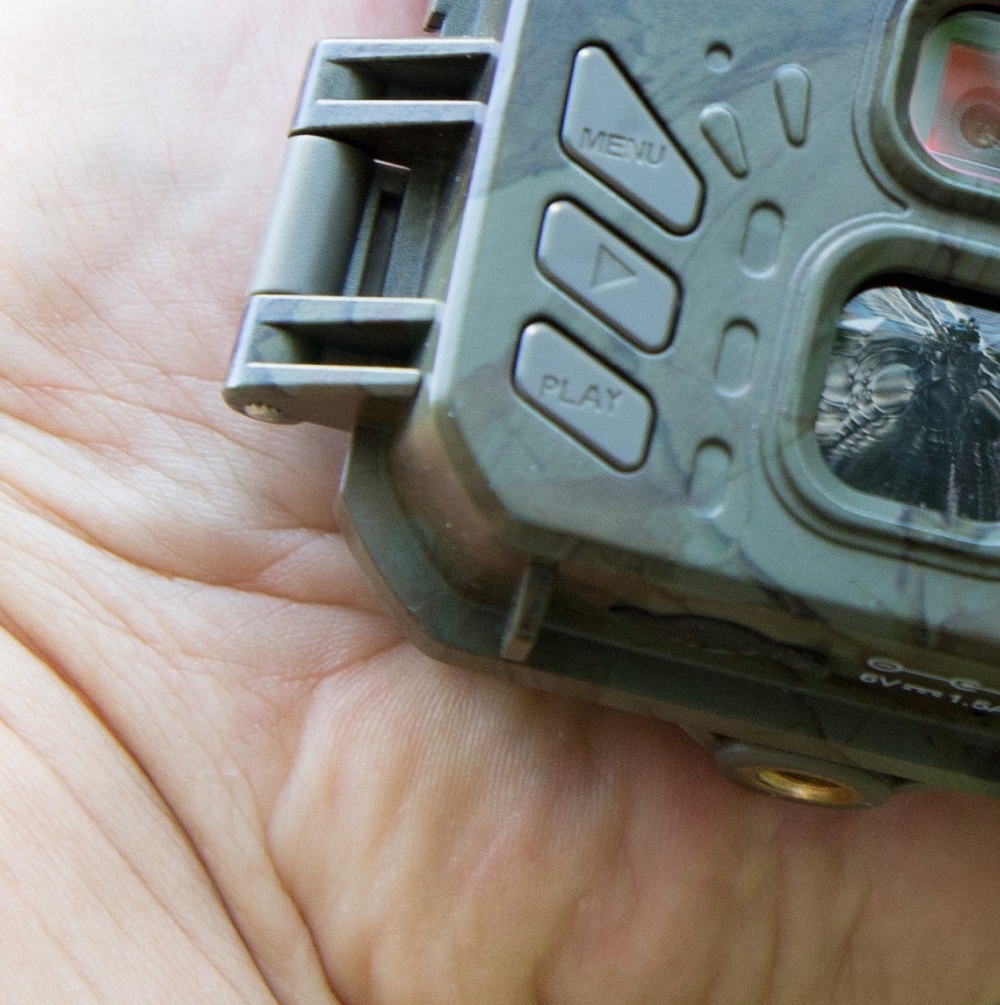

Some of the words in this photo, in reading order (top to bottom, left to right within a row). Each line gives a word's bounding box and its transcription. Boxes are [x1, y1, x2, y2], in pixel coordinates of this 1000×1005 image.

[579, 126, 667, 167] MENU
[540, 374, 622, 412] PLAY
[859, 672, 902, 688] 6V
